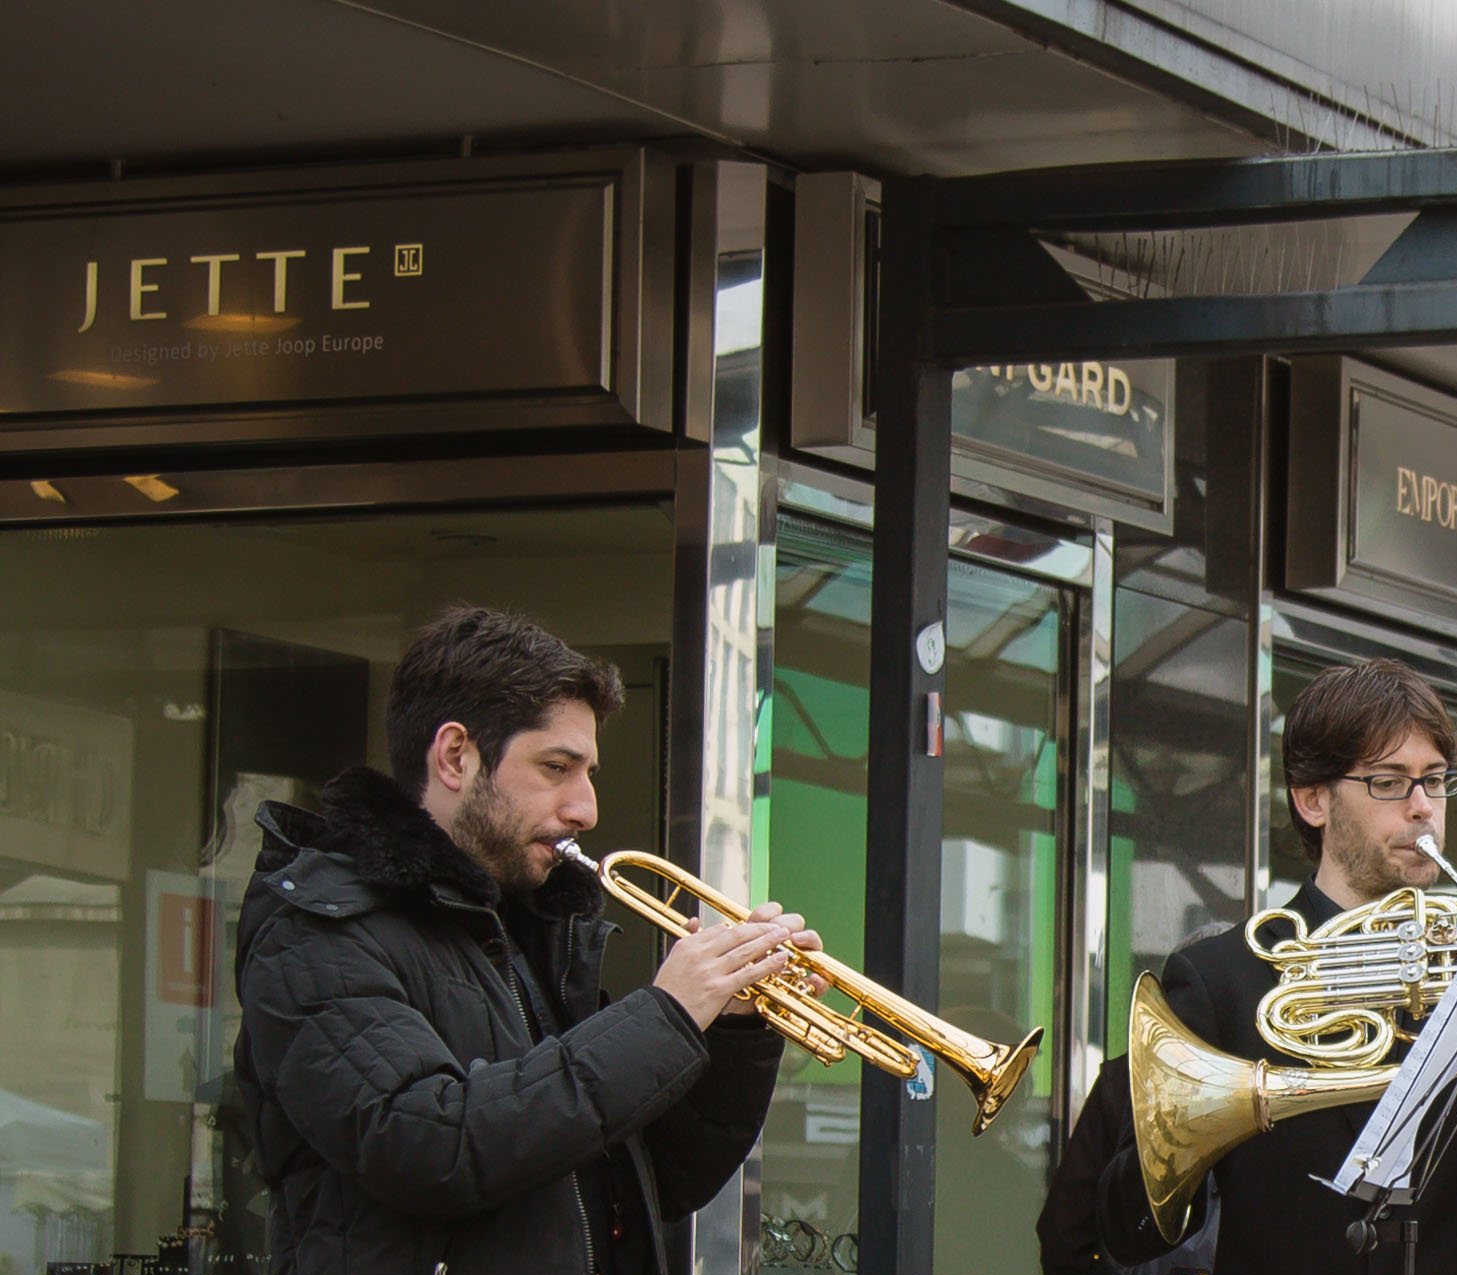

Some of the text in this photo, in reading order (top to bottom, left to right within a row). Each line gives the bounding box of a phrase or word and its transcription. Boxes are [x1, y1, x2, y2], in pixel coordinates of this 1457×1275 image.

[77, 246, 371, 334] JETTE
[198, 340, 217, 362] by
[275, 336, 316, 359] Joop
[322, 333, 384, 355] Europe
